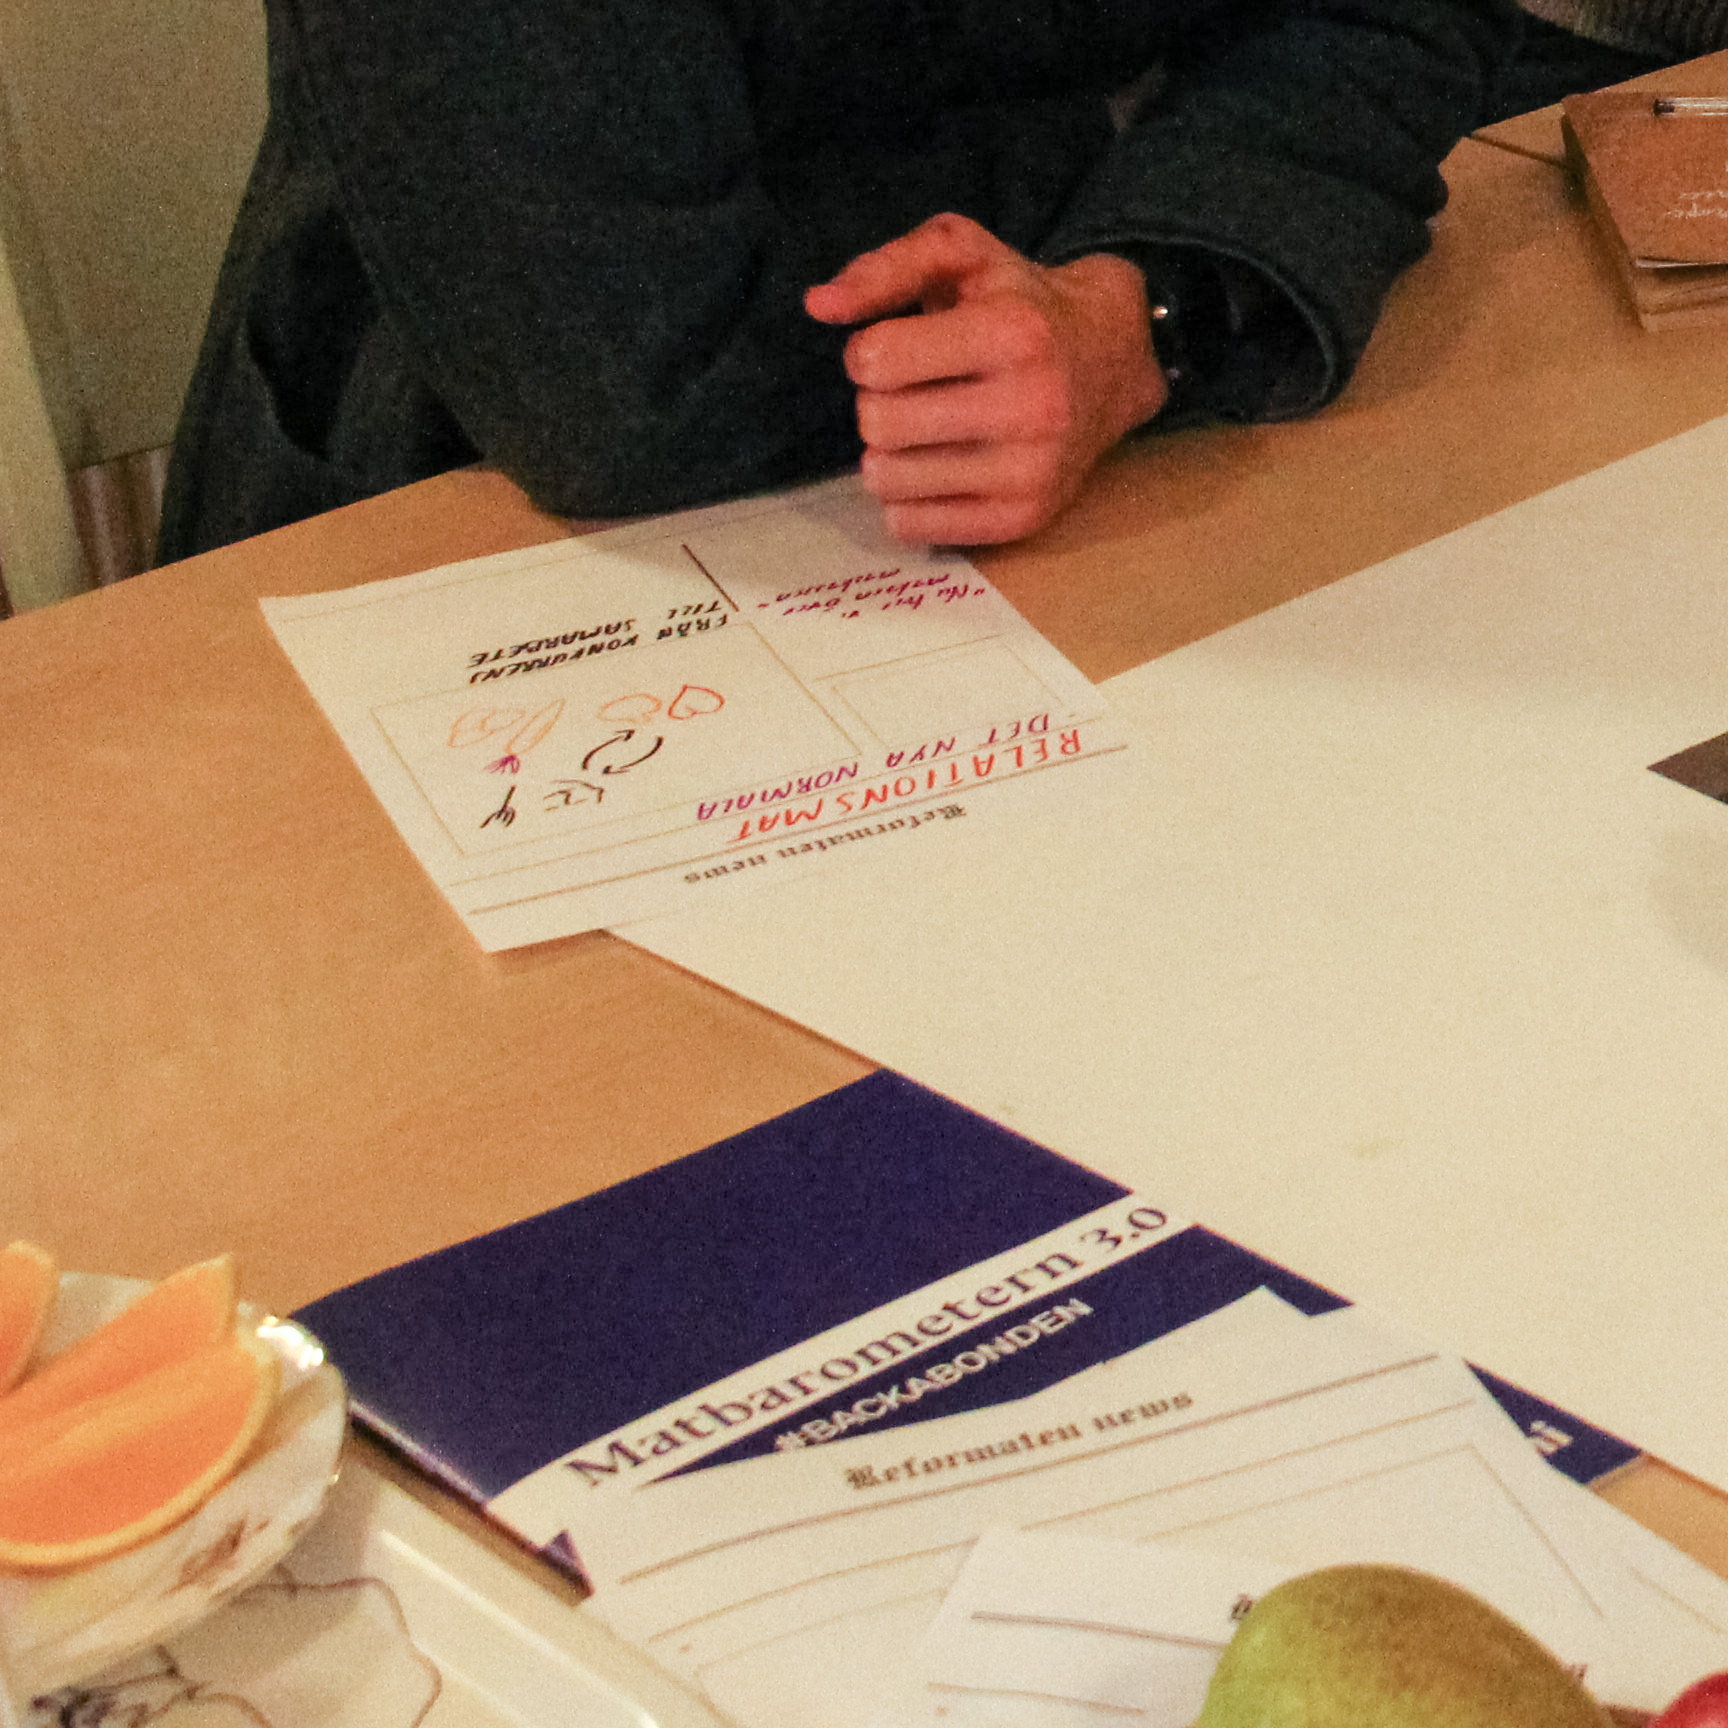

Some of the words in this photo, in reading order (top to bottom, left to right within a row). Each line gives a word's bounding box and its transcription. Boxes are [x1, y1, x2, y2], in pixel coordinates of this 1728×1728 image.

[884, 735, 957, 770] NYA
[984, 712, 1052, 749] DET
[695, 760, 860, 822] NORMALA
[783, 802, 968, 860] Reformaten
[683, 848, 768, 885] news
[563, 1246, 1085, 1490] Matbarometern
[1077, 1203, 1169, 1255] 3.0
[773, 1295, 1095, 1455] #BACKABONDEN
[844, 1418, 1084, 1492] Reformaten
[1091, 1390, 1195, 1433] news
